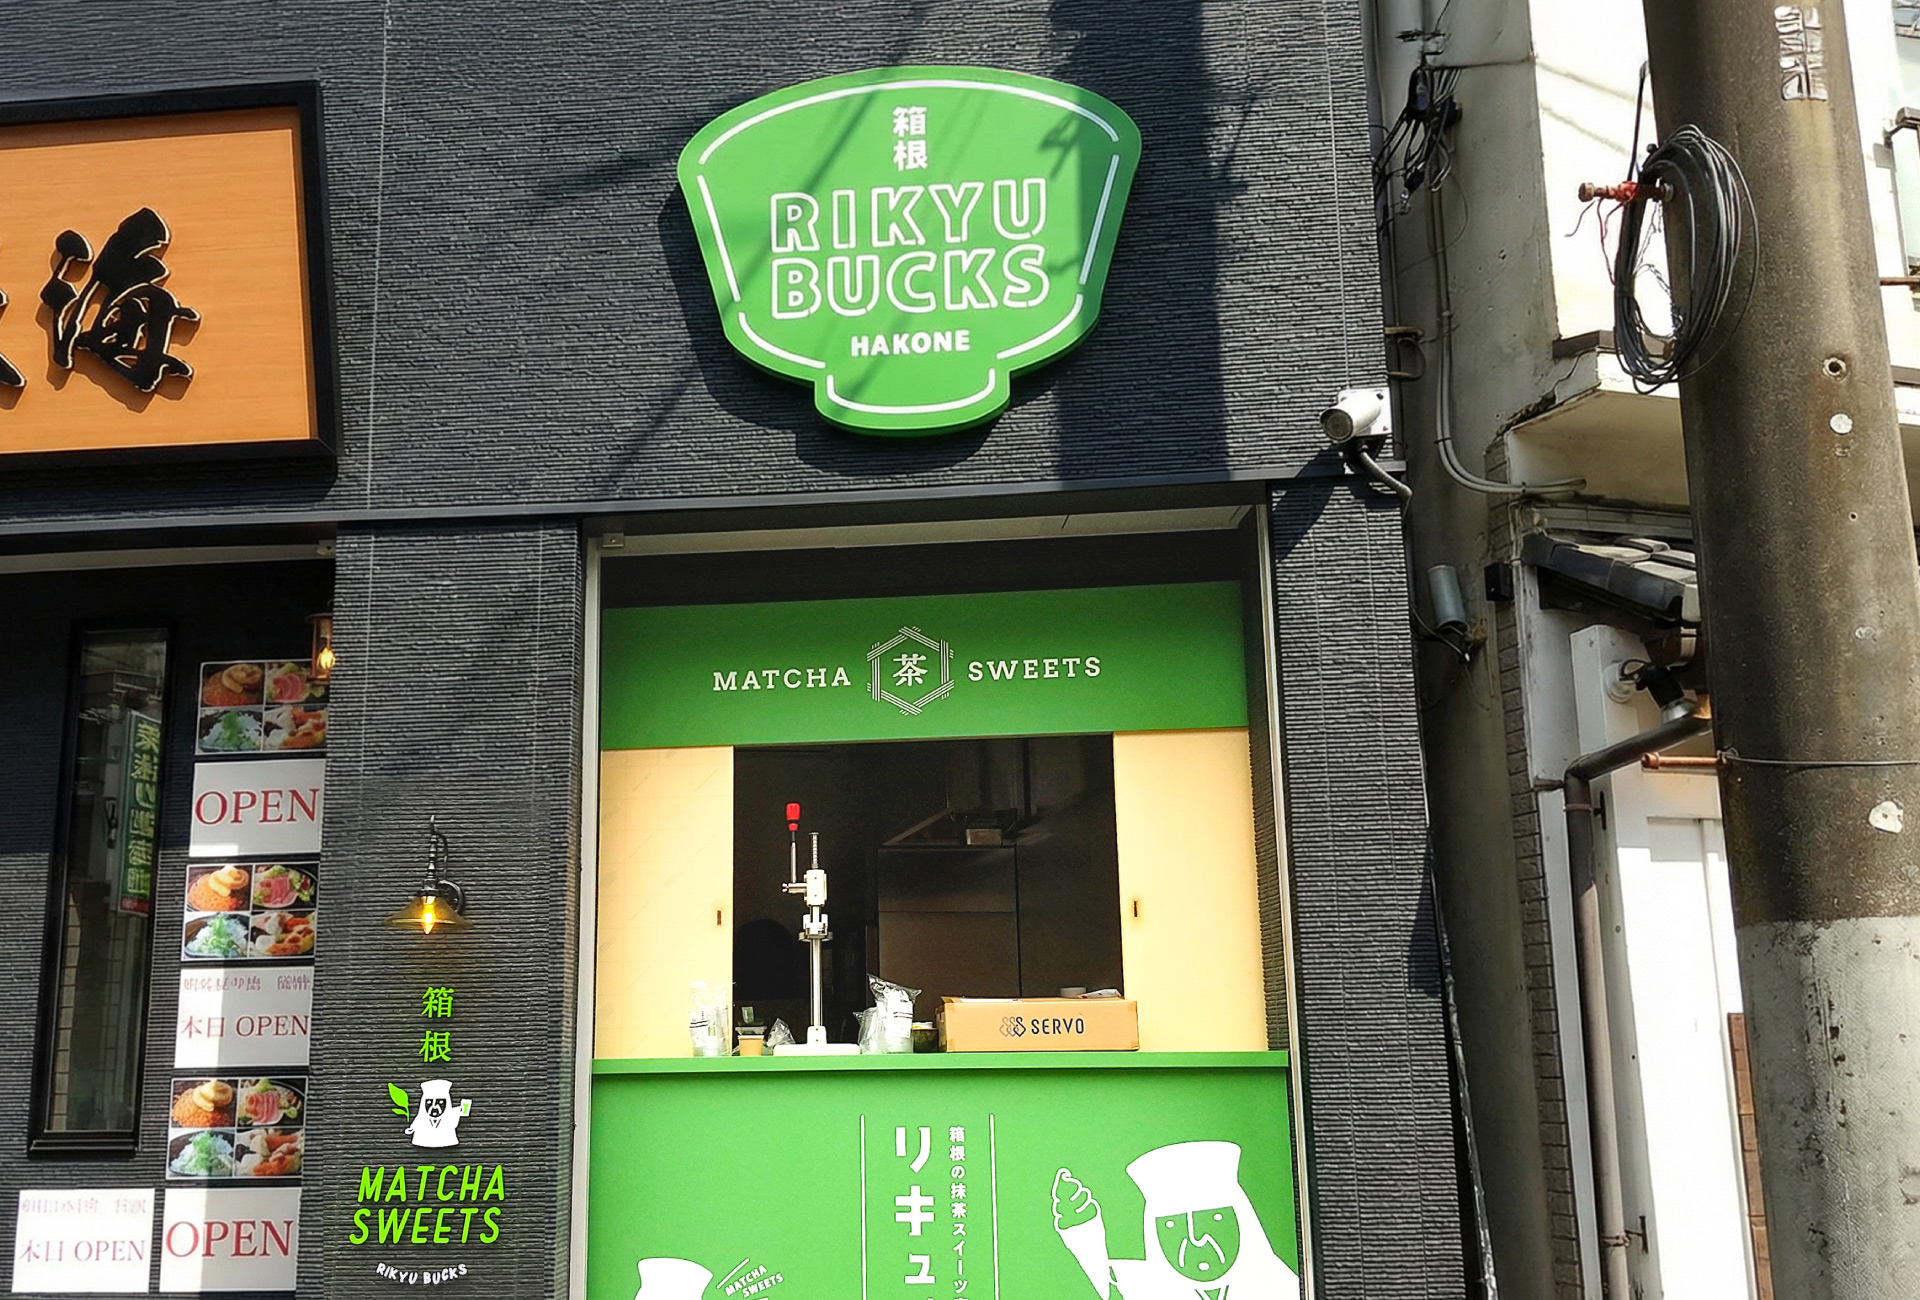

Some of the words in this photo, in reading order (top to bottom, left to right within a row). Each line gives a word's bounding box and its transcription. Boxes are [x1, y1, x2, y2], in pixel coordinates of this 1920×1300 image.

[892, 105, 929, 171] 箱根
[770, 178, 1047, 253] RIKYU
[771, 244, 1050, 320] BUCKS
[851, 330, 970, 357] HAKONE
[713, 666, 851, 691] MATCHA
[892, 653, 928, 687] 茶
[968, 656, 1101, 682] SWEETS
[195, 788, 320, 825] OPEN
[181, 1015, 225, 1038] 本日
[235, 1014, 309, 1037] OPEN
[419, 986, 454, 1062] 箱根
[1031, 1018, 1084, 1035] SERVO
[357, 1165, 504, 1202] MATCHA
[349, 1207, 501, 1244] SWEETS
[895, 1127, 935, 1300] リキュ
[949, 1126, 968, 1300] 箱根の抹茶スイーツ
[74, 1240, 145, 1262] OPEN
[165, 1220, 294, 1258] OPEN
[376, 1262, 418, 1285] RIKYU
[423, 1264, 468, 1285] BUCKS
[724, 1264, 768, 1297] MATCHA
[742, 1273, 784, 1298] SWEETS
